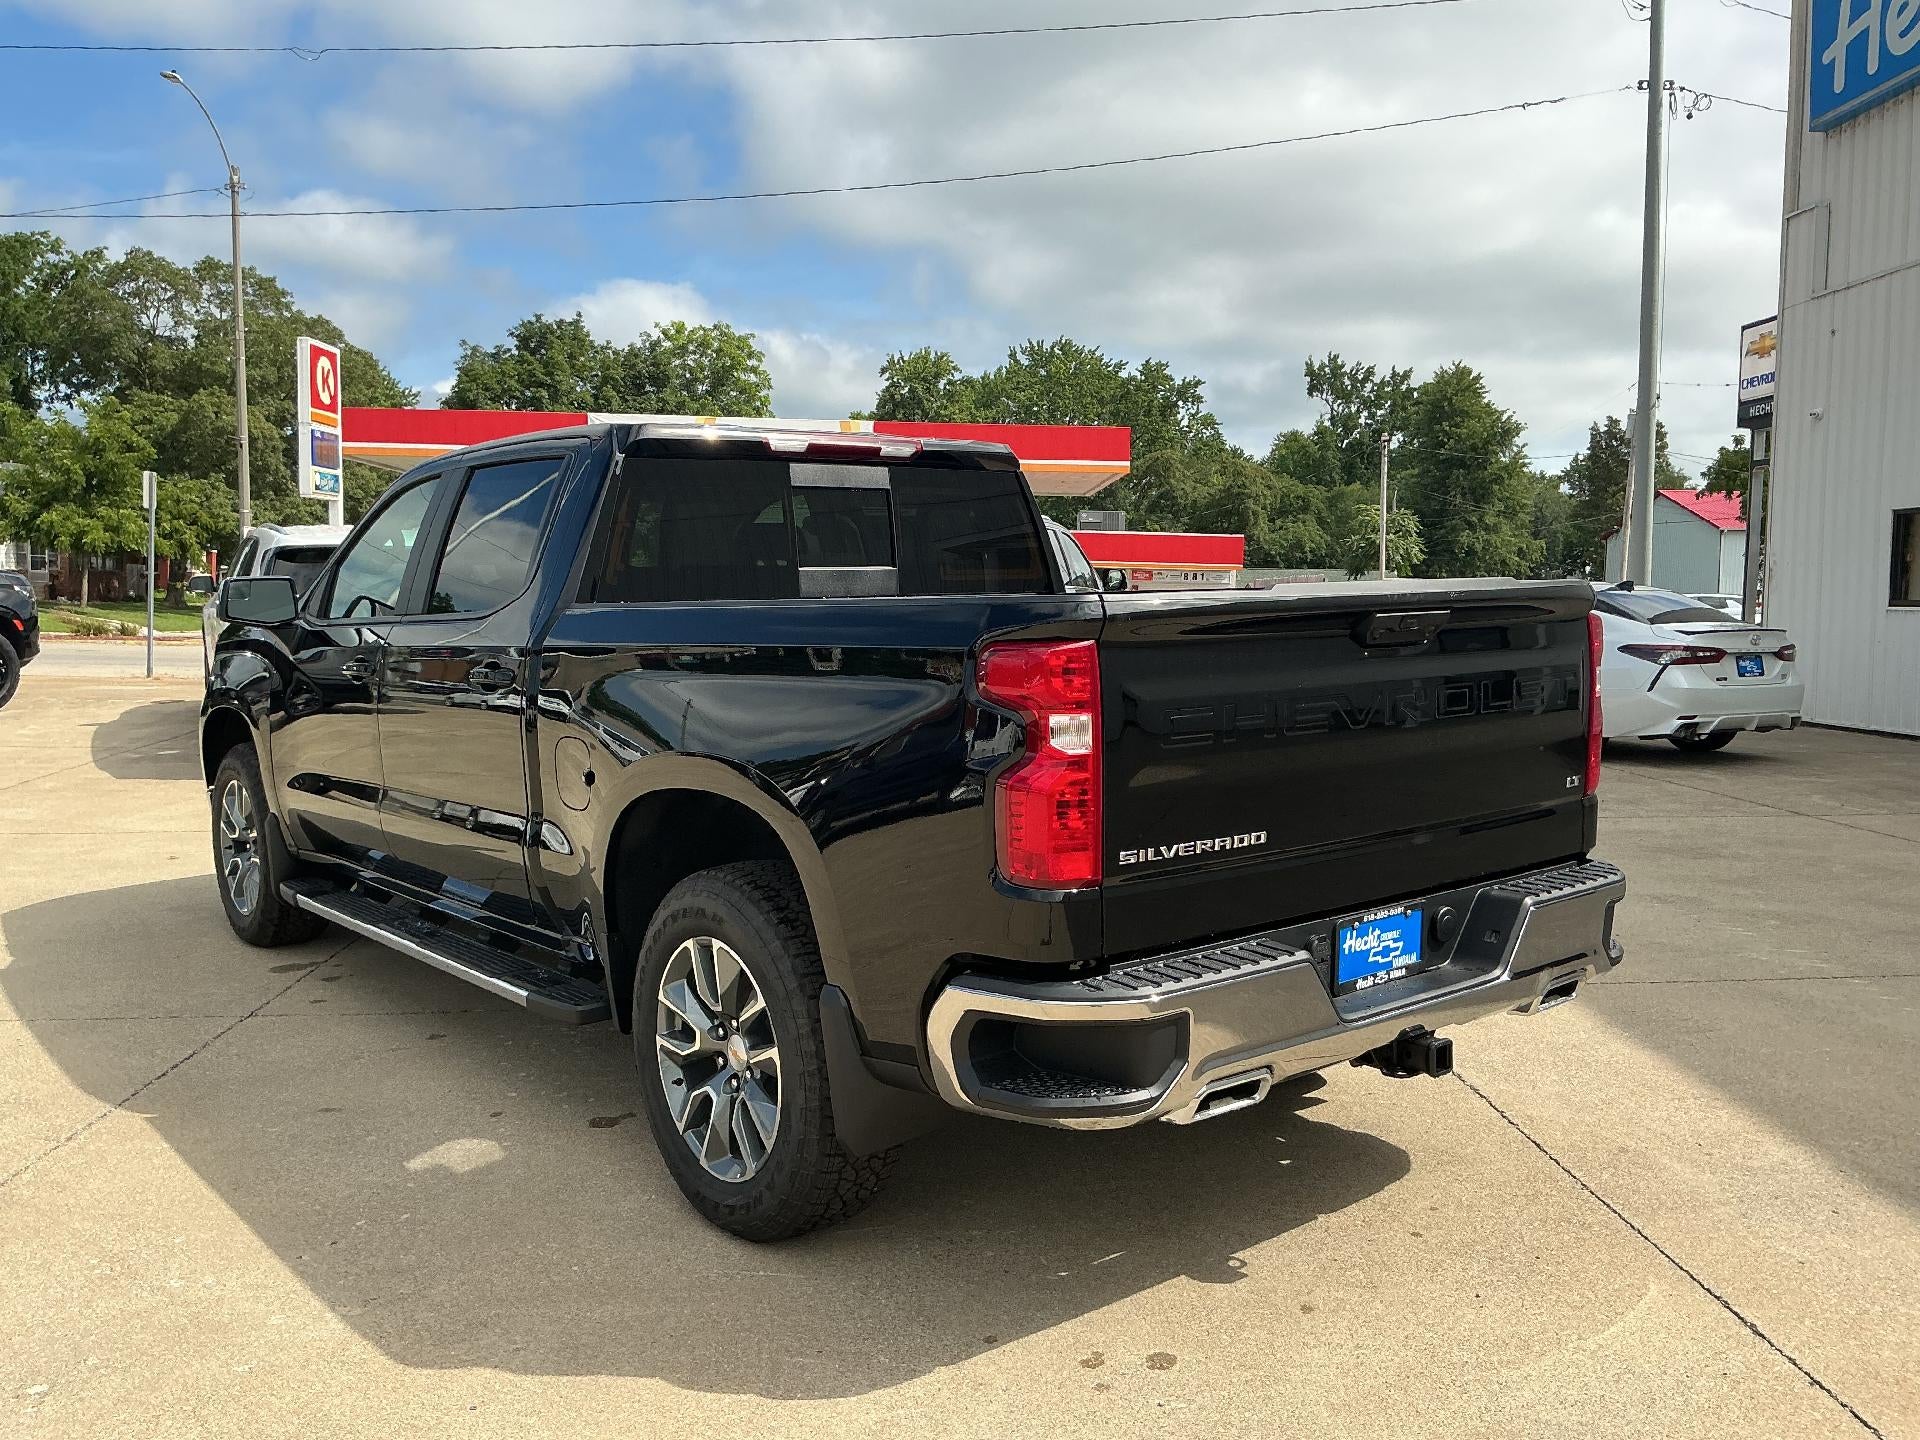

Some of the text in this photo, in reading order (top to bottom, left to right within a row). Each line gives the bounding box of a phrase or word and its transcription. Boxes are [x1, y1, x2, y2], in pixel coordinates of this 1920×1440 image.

[321, 366, 334, 397] K
[1161, 672, 1576, 748] CHEVROLET
[1566, 775, 1581, 788] LT
[1119, 829, 1268, 866] SILVERADO
[1343, 926, 1381, 955] Hecht
